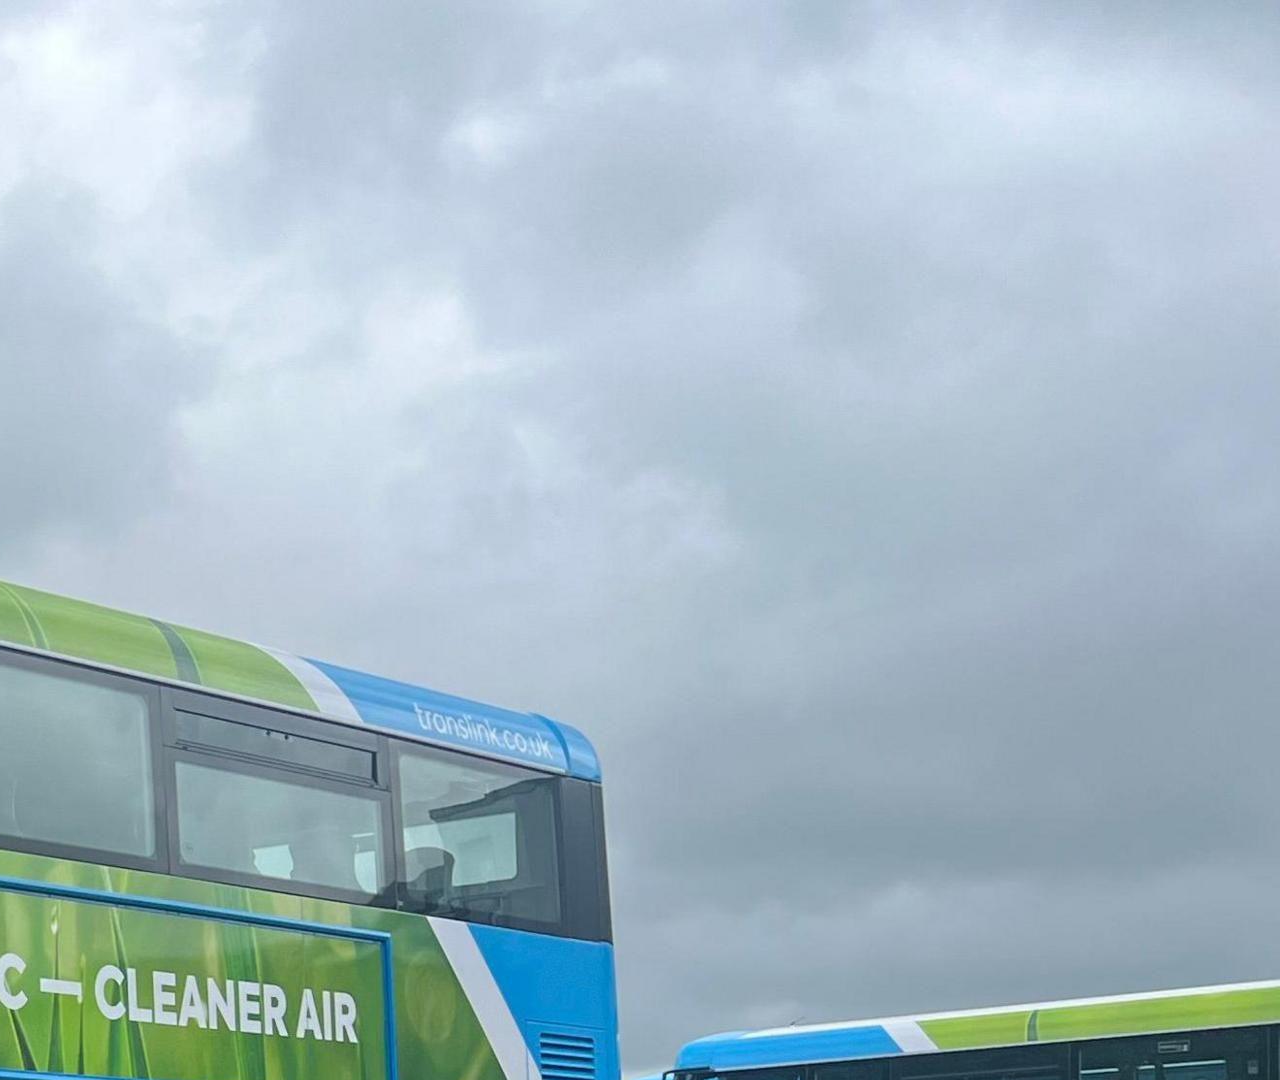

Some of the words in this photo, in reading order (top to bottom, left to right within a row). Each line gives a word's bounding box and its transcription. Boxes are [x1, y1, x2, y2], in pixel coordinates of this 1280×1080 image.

[414, 702, 552, 758] translink.co.uk
[94, 964, 288, 1037] CLEANER
[296, 988, 358, 1043] AIR
